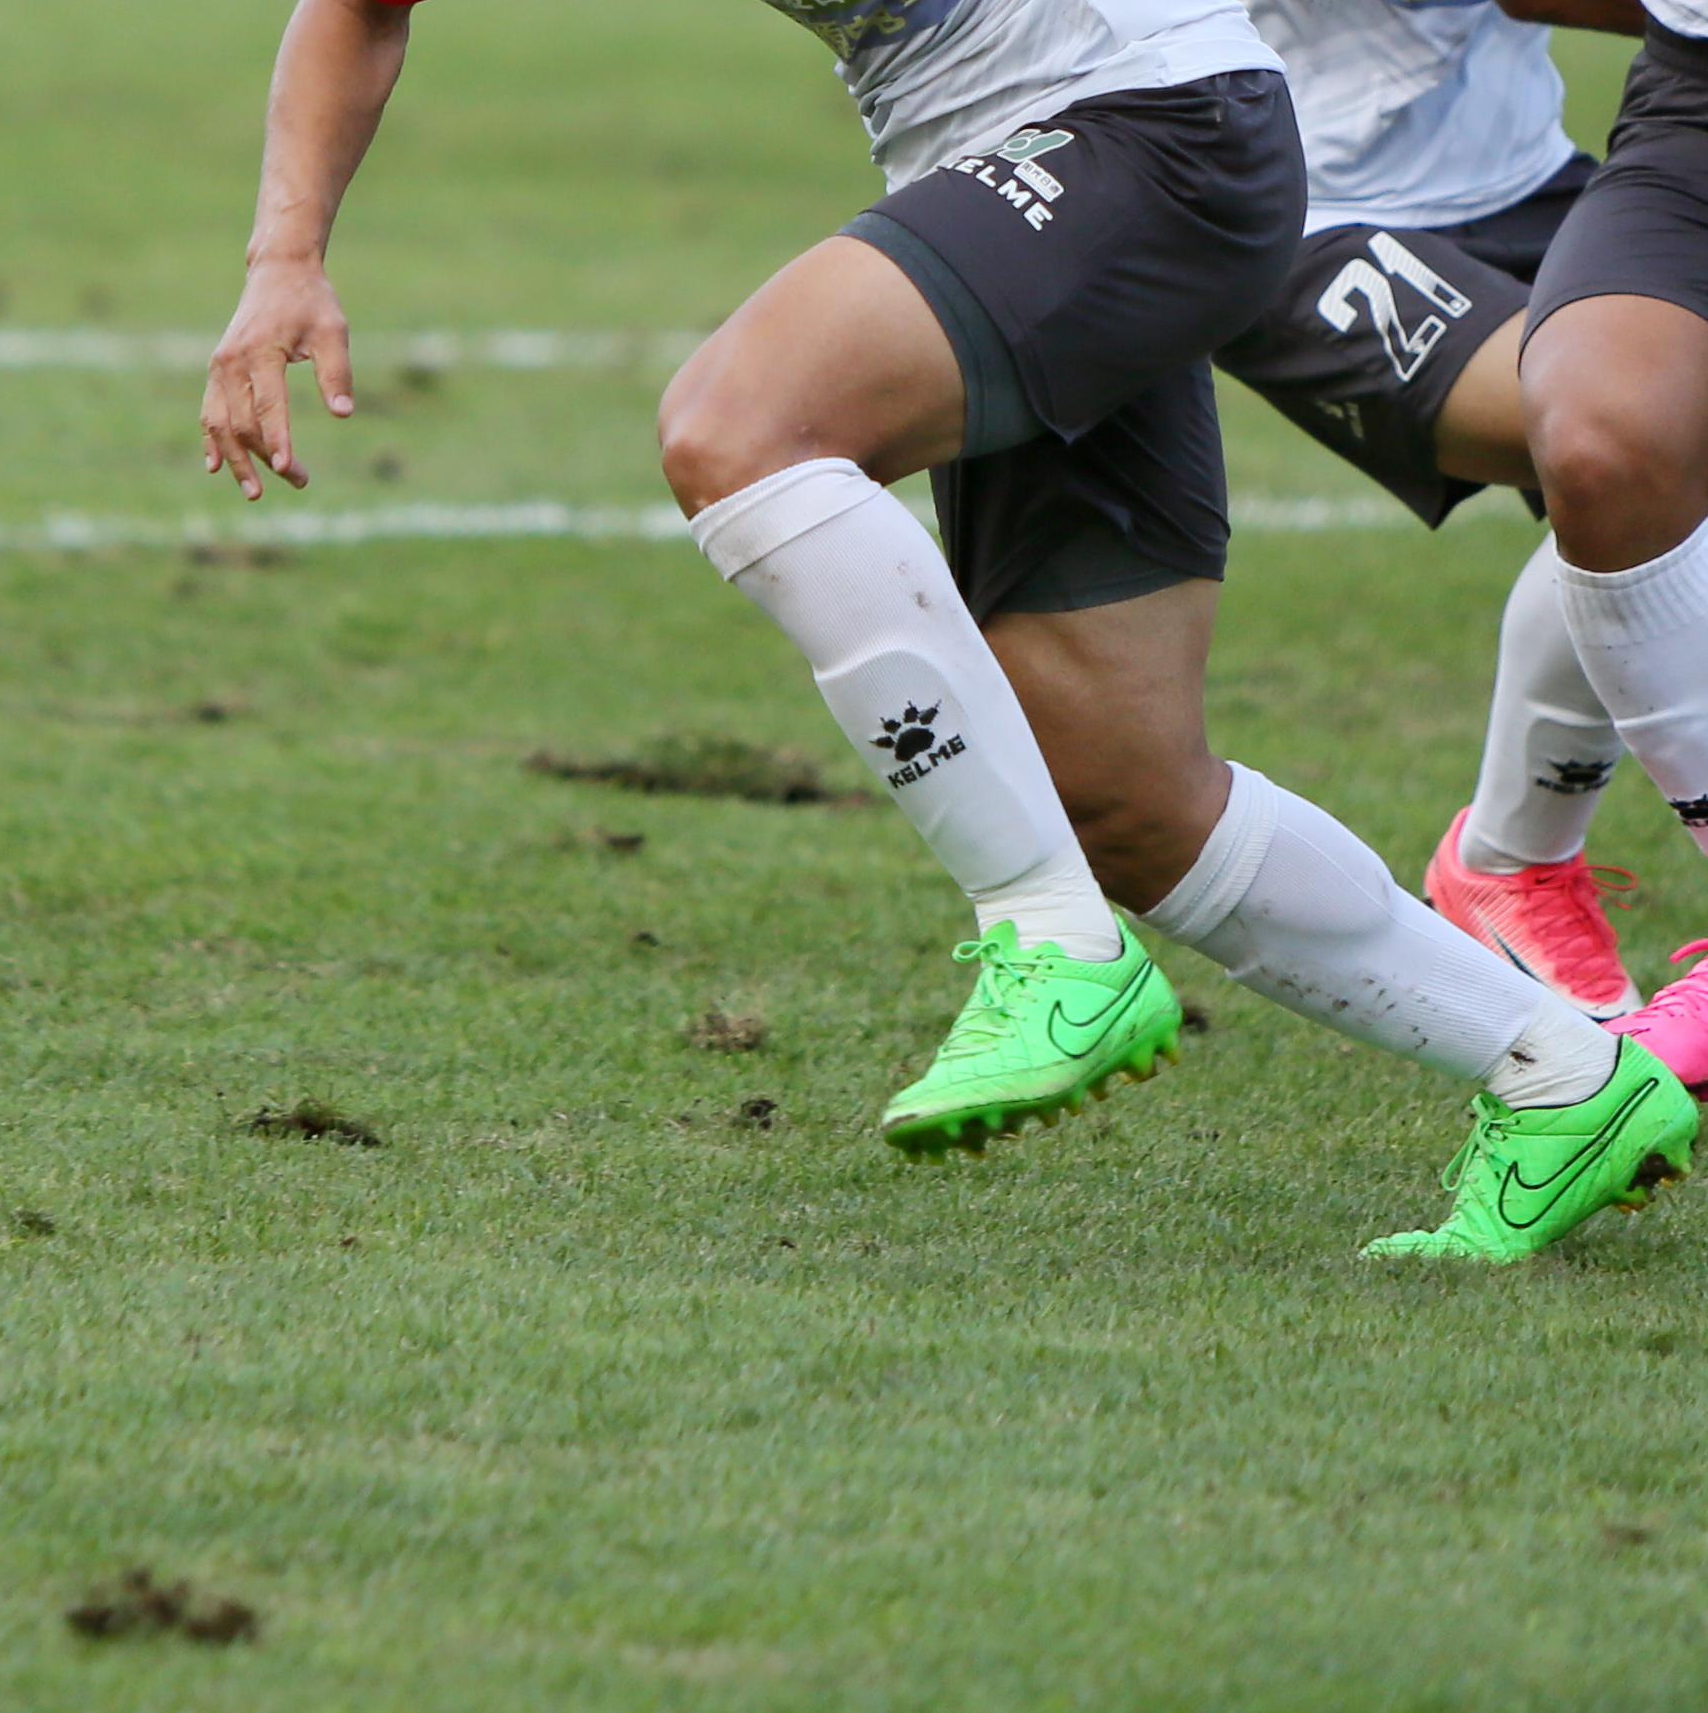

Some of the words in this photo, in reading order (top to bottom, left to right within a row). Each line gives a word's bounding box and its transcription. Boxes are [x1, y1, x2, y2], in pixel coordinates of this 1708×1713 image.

[945, 157, 1054, 232] ELME
[1317, 230, 1473, 382] 21
[887, 734, 967, 789] KELME
